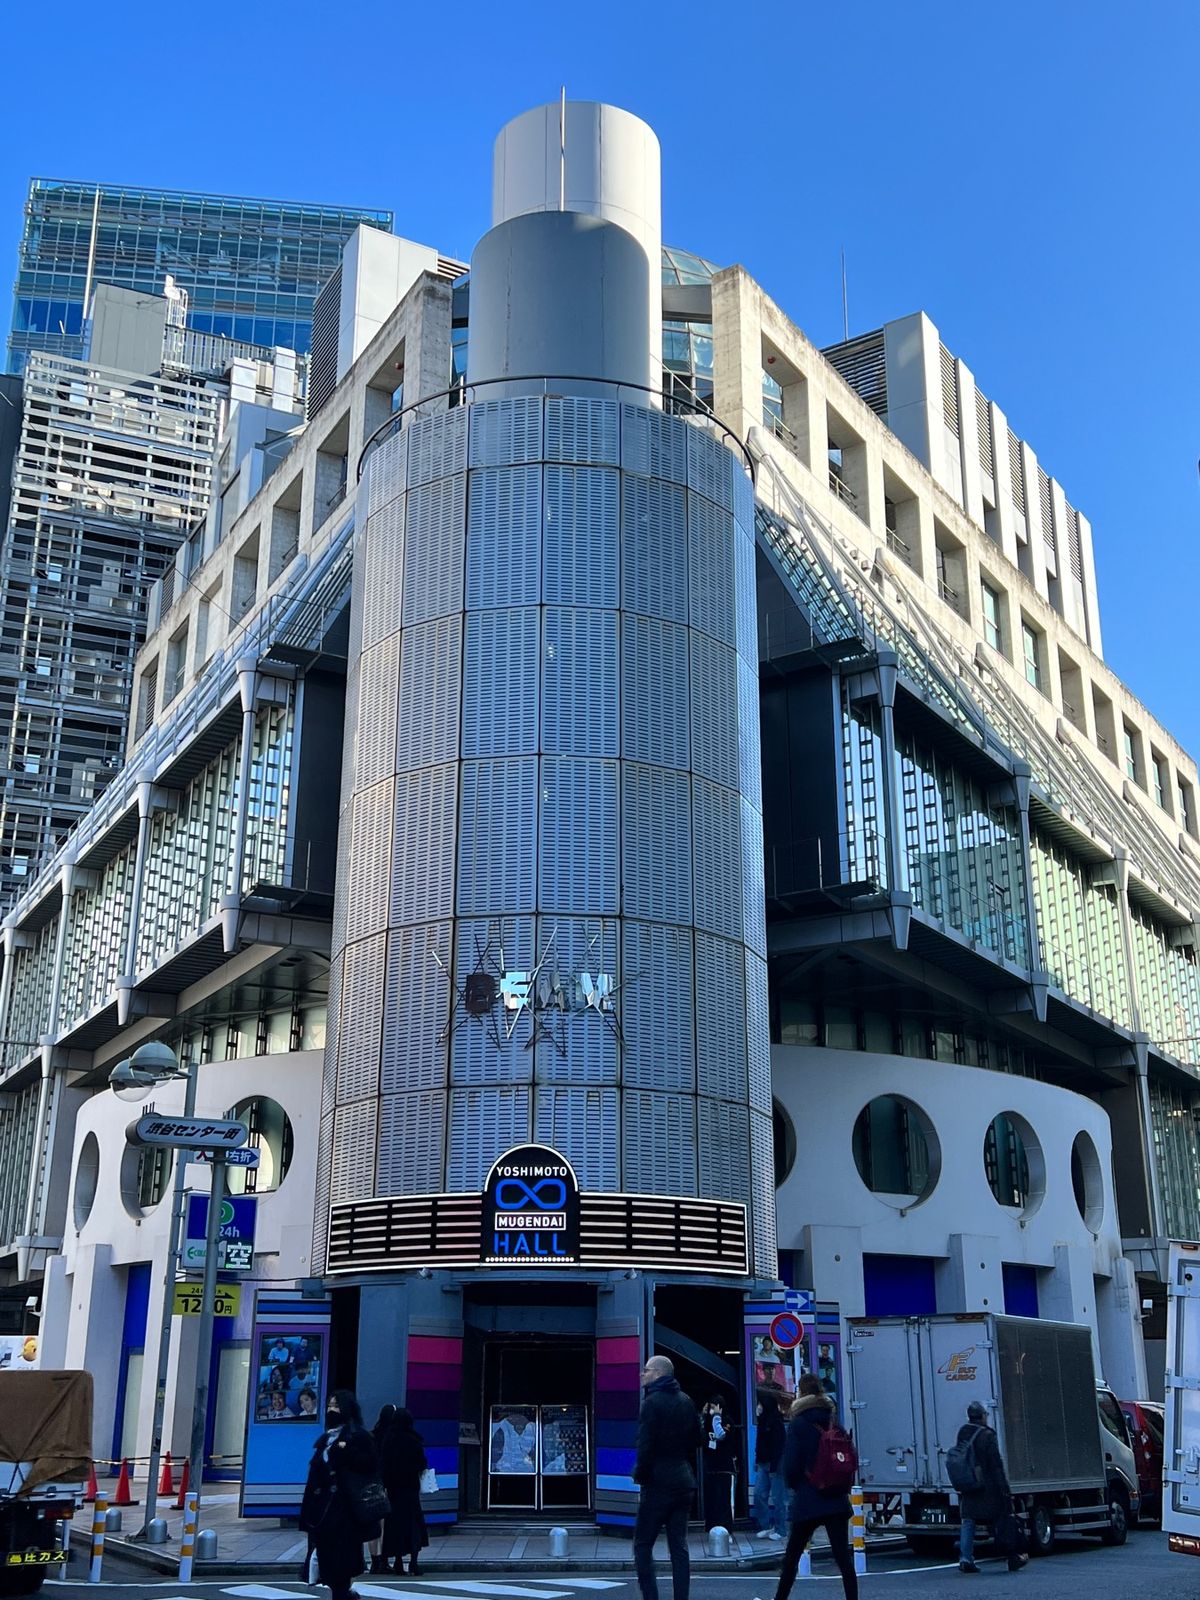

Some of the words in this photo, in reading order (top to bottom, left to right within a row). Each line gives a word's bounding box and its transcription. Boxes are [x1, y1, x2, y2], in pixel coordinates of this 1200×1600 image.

[145, 1122, 241, 1140] 渋谷センター街
[496, 1166, 568, 1177] YOSHIMOTO
[498, 1216, 563, 1227] MUGENDAI
[494, 1233, 566, 1255] HALL
[226, 1242, 252, 1269] 空
[181, 1299, 232, 1314] 120円
